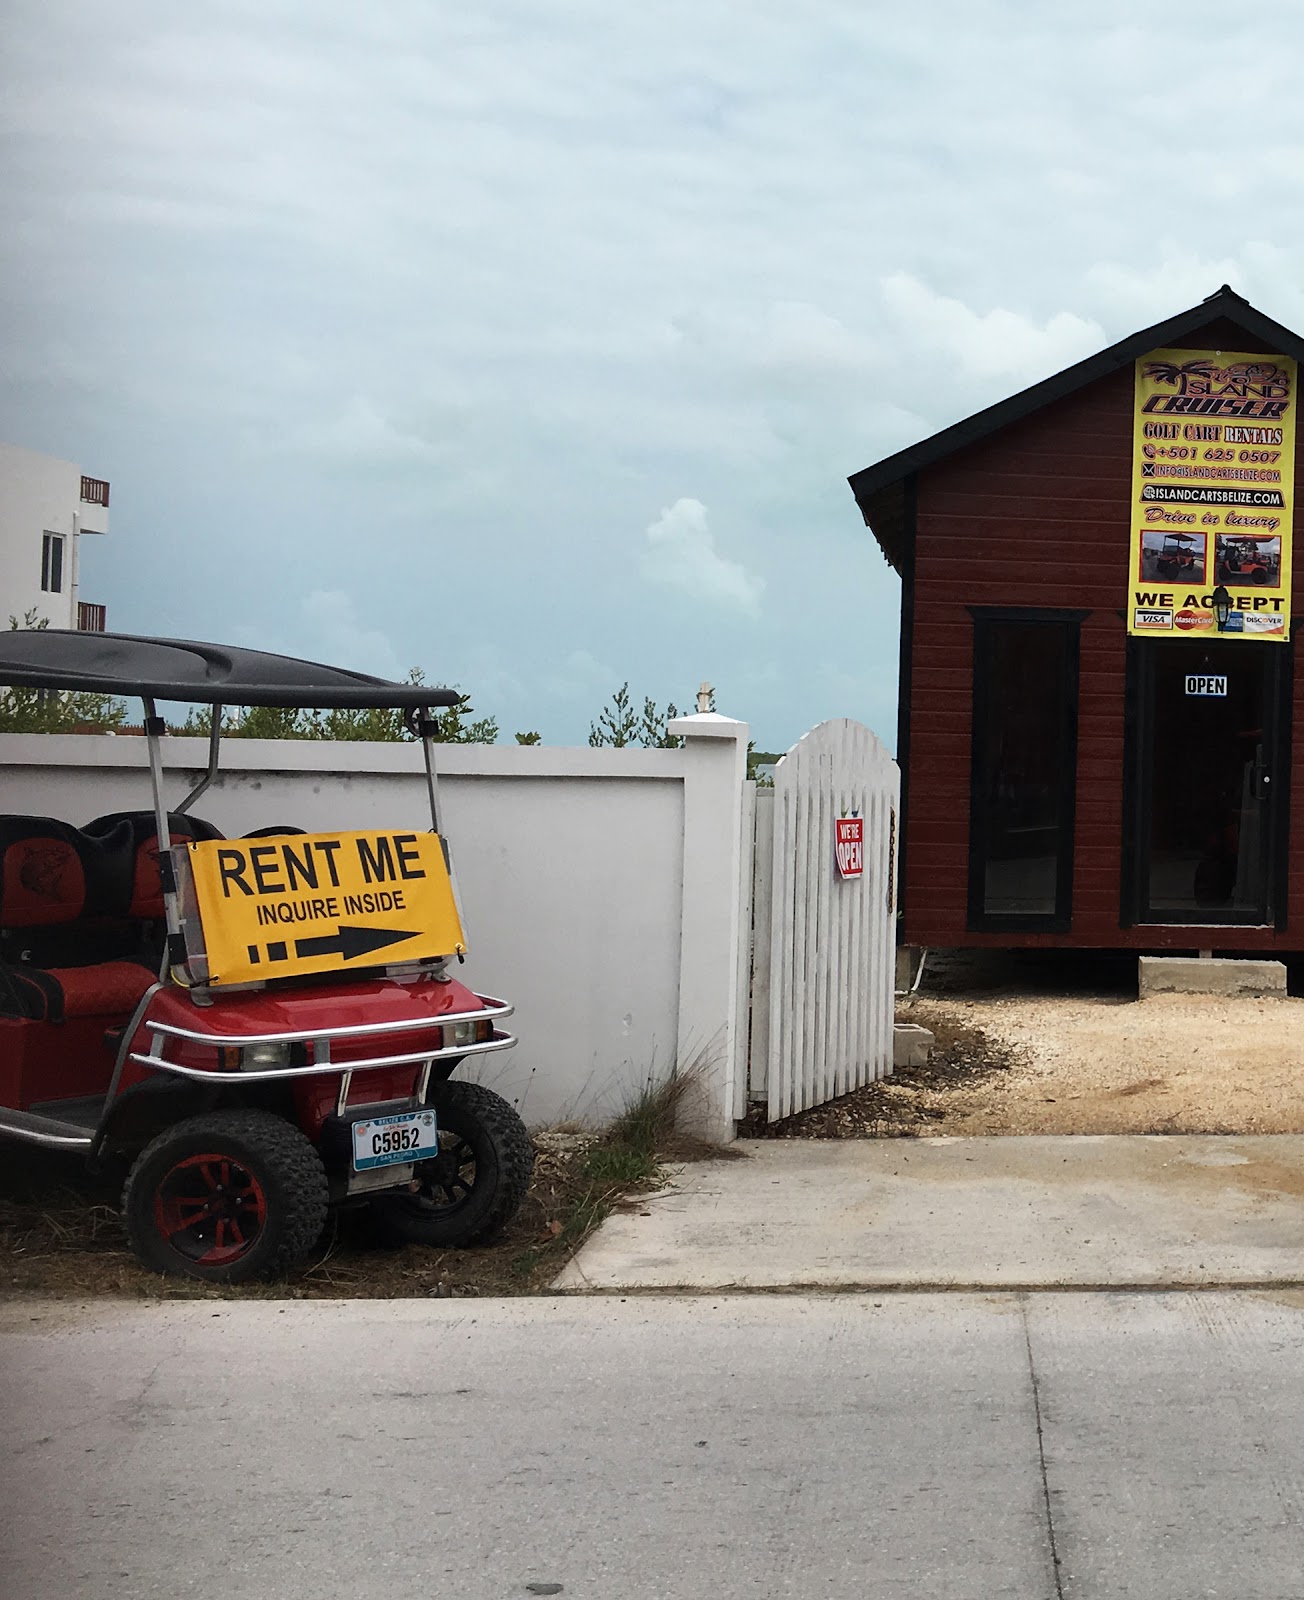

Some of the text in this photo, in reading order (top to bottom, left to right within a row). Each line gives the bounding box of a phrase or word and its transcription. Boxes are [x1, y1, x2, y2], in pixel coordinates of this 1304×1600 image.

[1142, 395, 1288, 419] CRUISER
[1144, 423, 1282, 444] GOLF CART RENTALS
[1158, 446, 1280, 463] +501 625 0507
[1155, 488, 1280, 505] ISLANDCARTSBELIZE.COM
[1145, 507, 1280, 531] Drive in luxury
[1135, 592, 1174, 607] WE
[1143, 615, 1165, 623] VISA
[1175, 616, 1214, 624] MasterCard
[1246, 616, 1282, 625] DISCOVER
[1187, 677, 1225, 694] OPEN
[217, 834, 426, 898] RENT ME
[838, 841, 862, 871] OPEN
[256, 890, 406, 926] INQUIRE INSIDE
[372, 1128, 419, 1154] C5952
